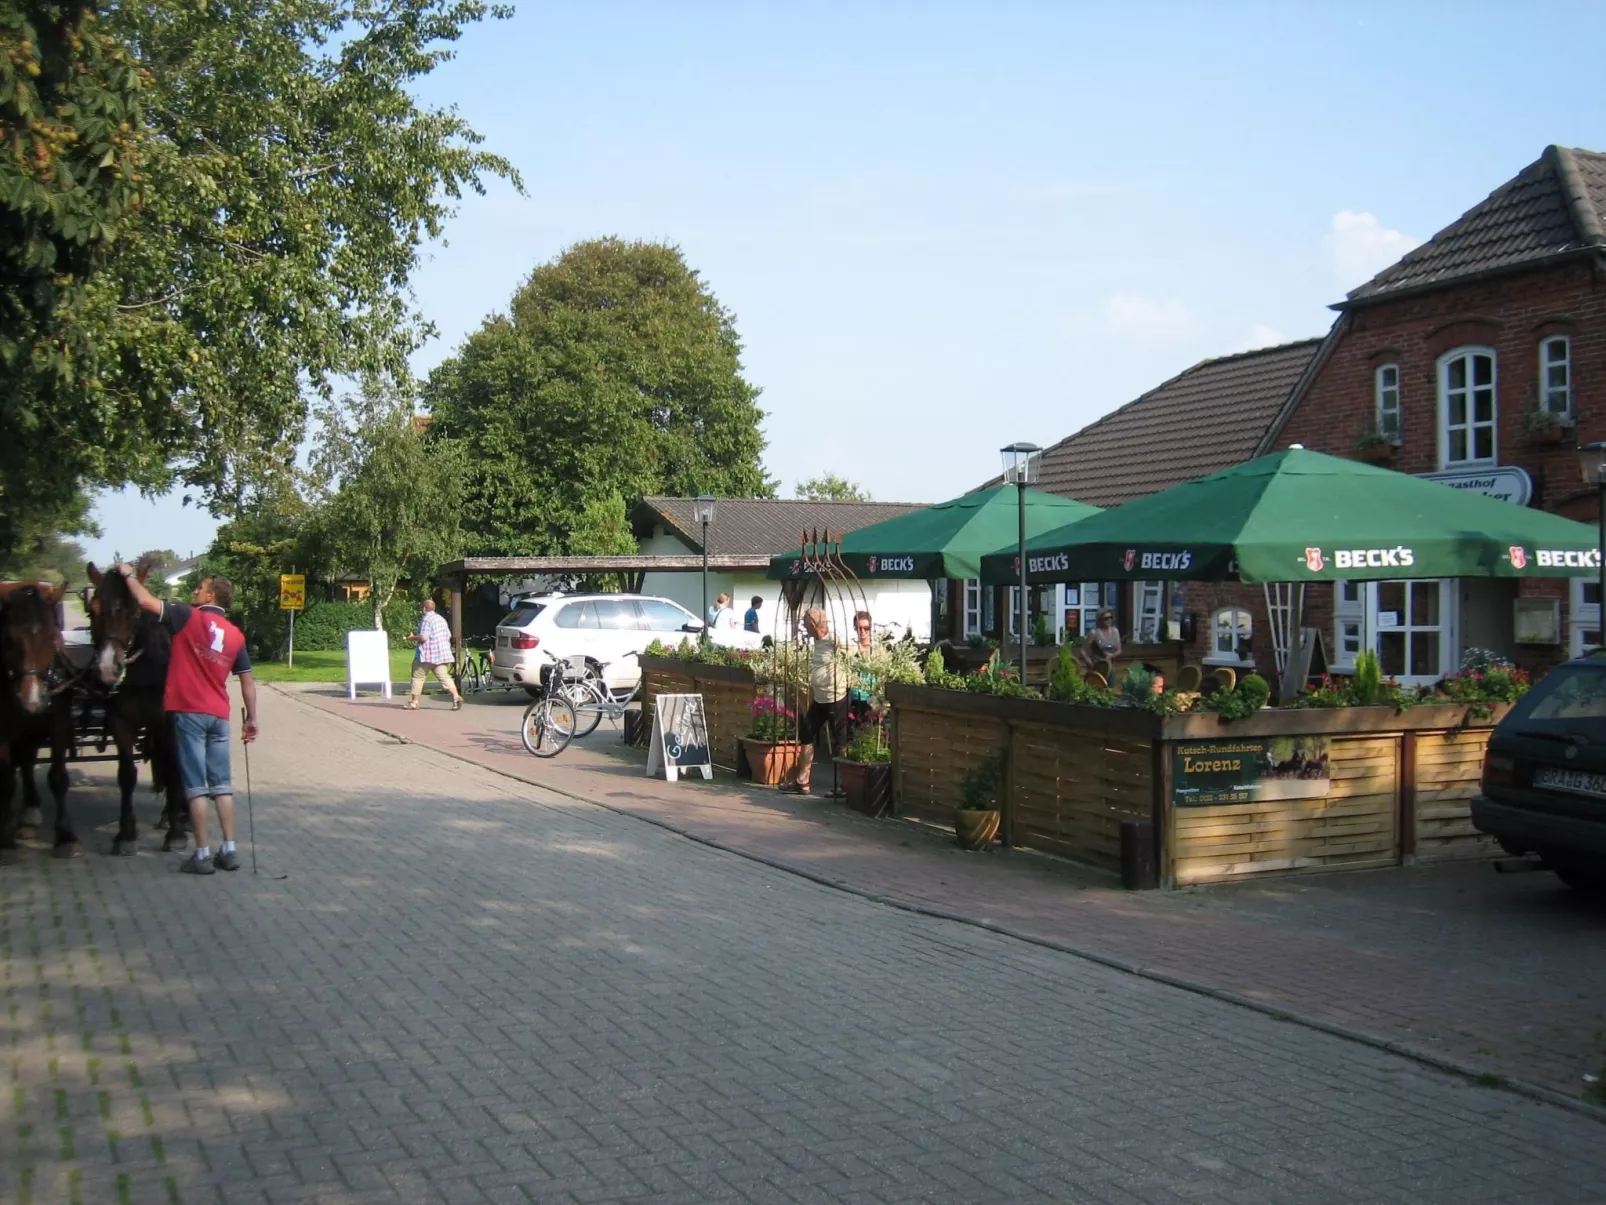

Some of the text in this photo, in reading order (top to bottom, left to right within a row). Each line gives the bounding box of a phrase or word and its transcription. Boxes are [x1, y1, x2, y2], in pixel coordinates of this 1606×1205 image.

[881, 555, 914, 571] BECK'S
[1029, 552, 1069, 573] BECK'S
[1141, 550, 1192, 570] BECK'S
[1335, 546, 1414, 569] BECK'S
[1184, 757, 1242, 773] Lorenz
